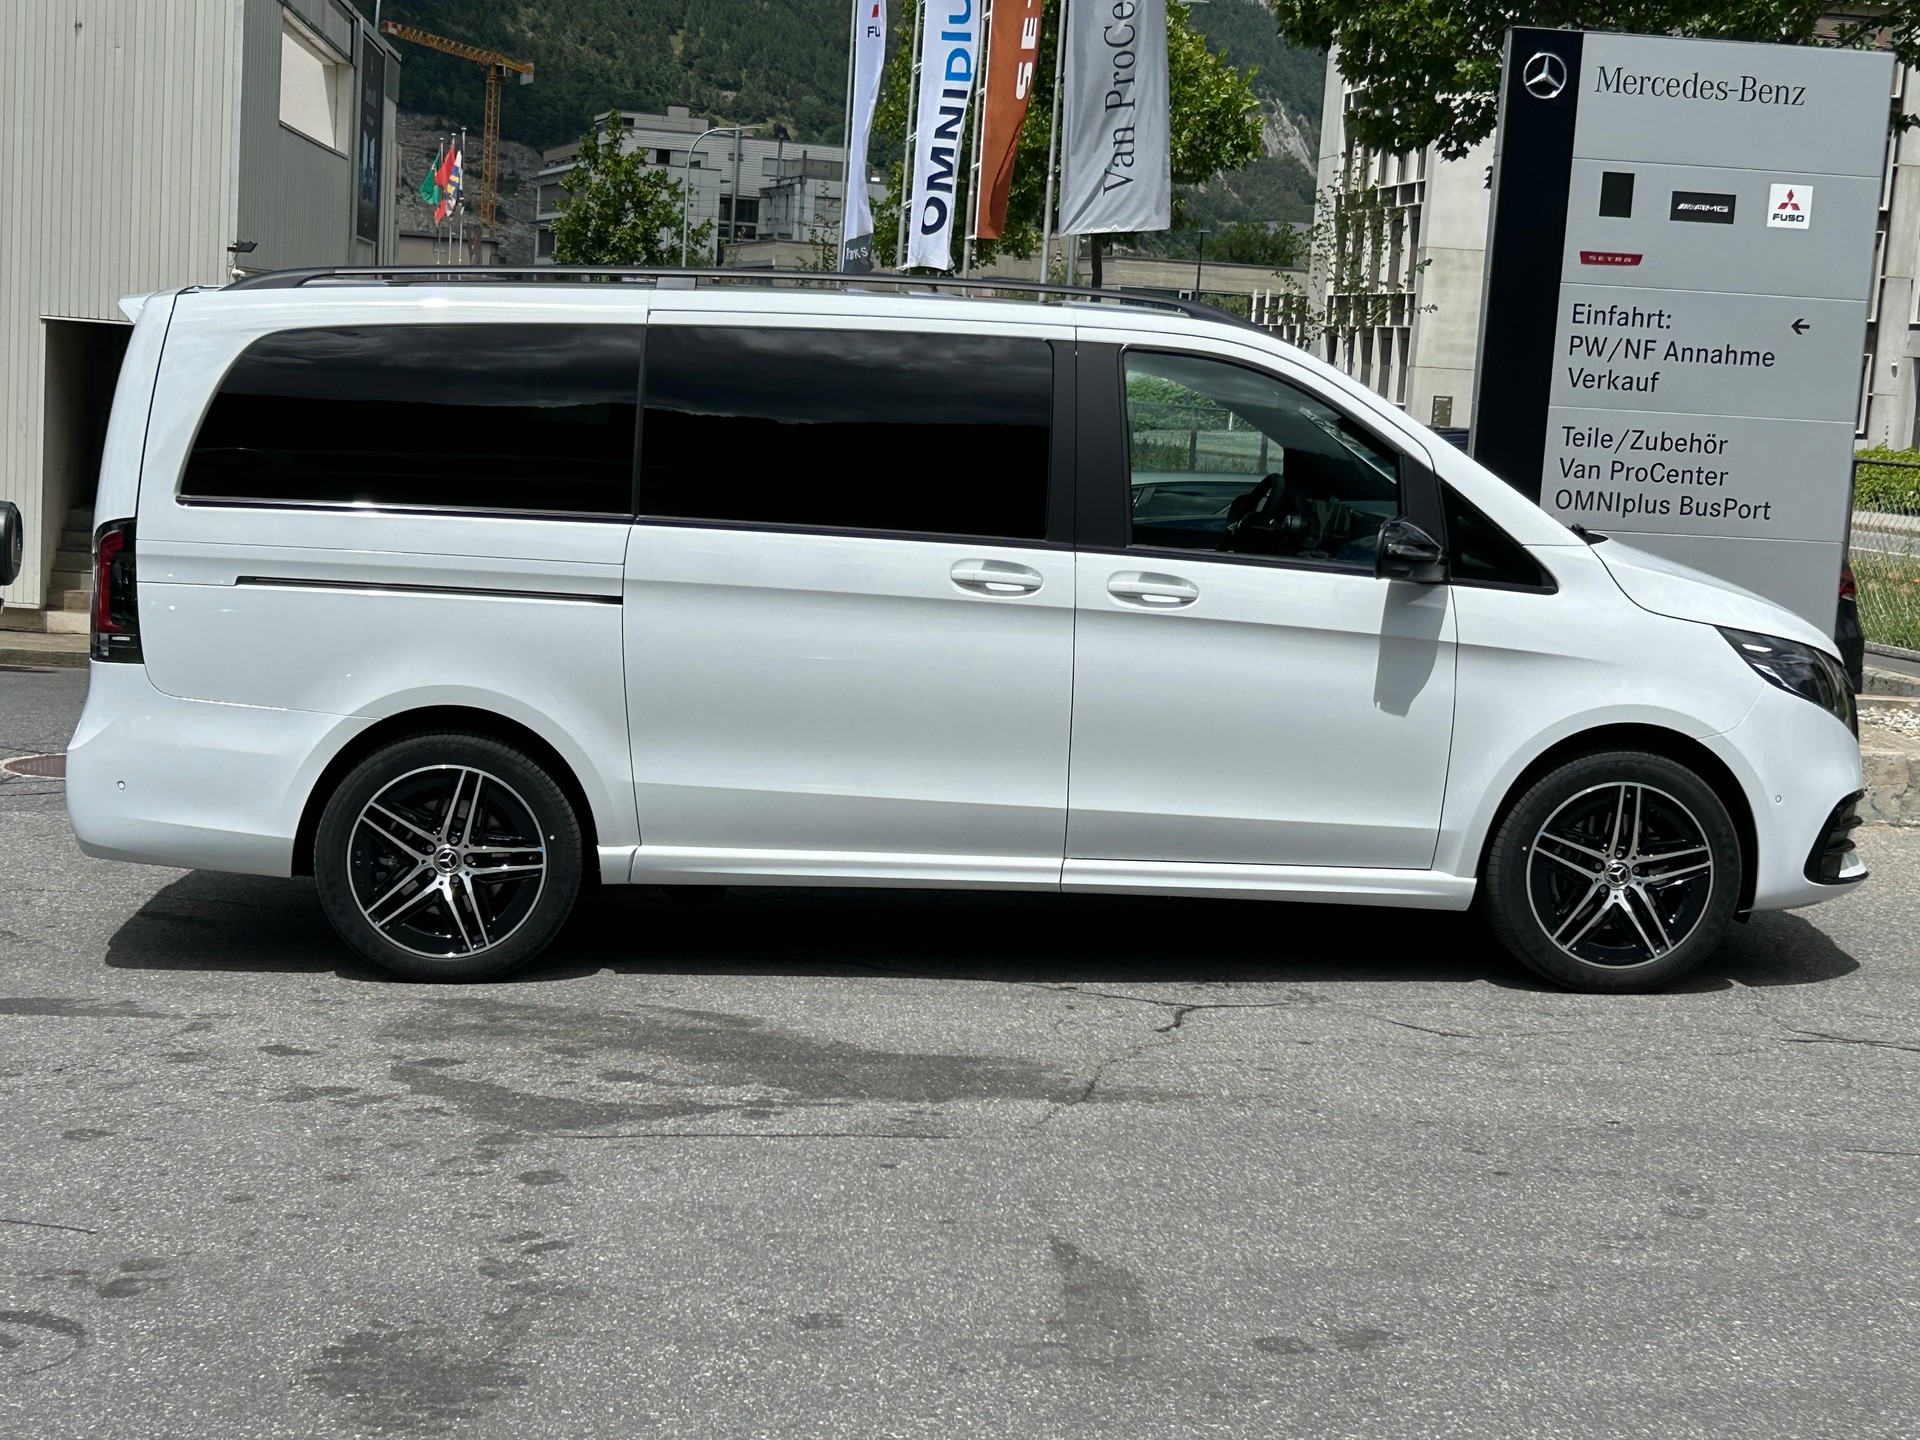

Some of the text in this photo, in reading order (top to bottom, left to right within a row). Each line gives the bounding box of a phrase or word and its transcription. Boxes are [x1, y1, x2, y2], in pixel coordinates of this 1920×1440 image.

[1015, 0, 1038, 100] SE
[1102, 1, 1136, 196] Van ProCe
[1594, 65, 1806, 106] Mercedes-Benz
[1772, 213, 1805, 223] FUSO
[1571, 303, 1672, 330] Einfahrt:
[1569, 335, 1775, 368] PW/NF Annahme
[1567, 366, 1660, 393] Verkauf
[1561, 426, 1729, 456] Teile/Zubehör
[1559, 457, 1729, 487] Van ProCenter
[1555, 488, 1772, 521] OMNIplus BusPort
